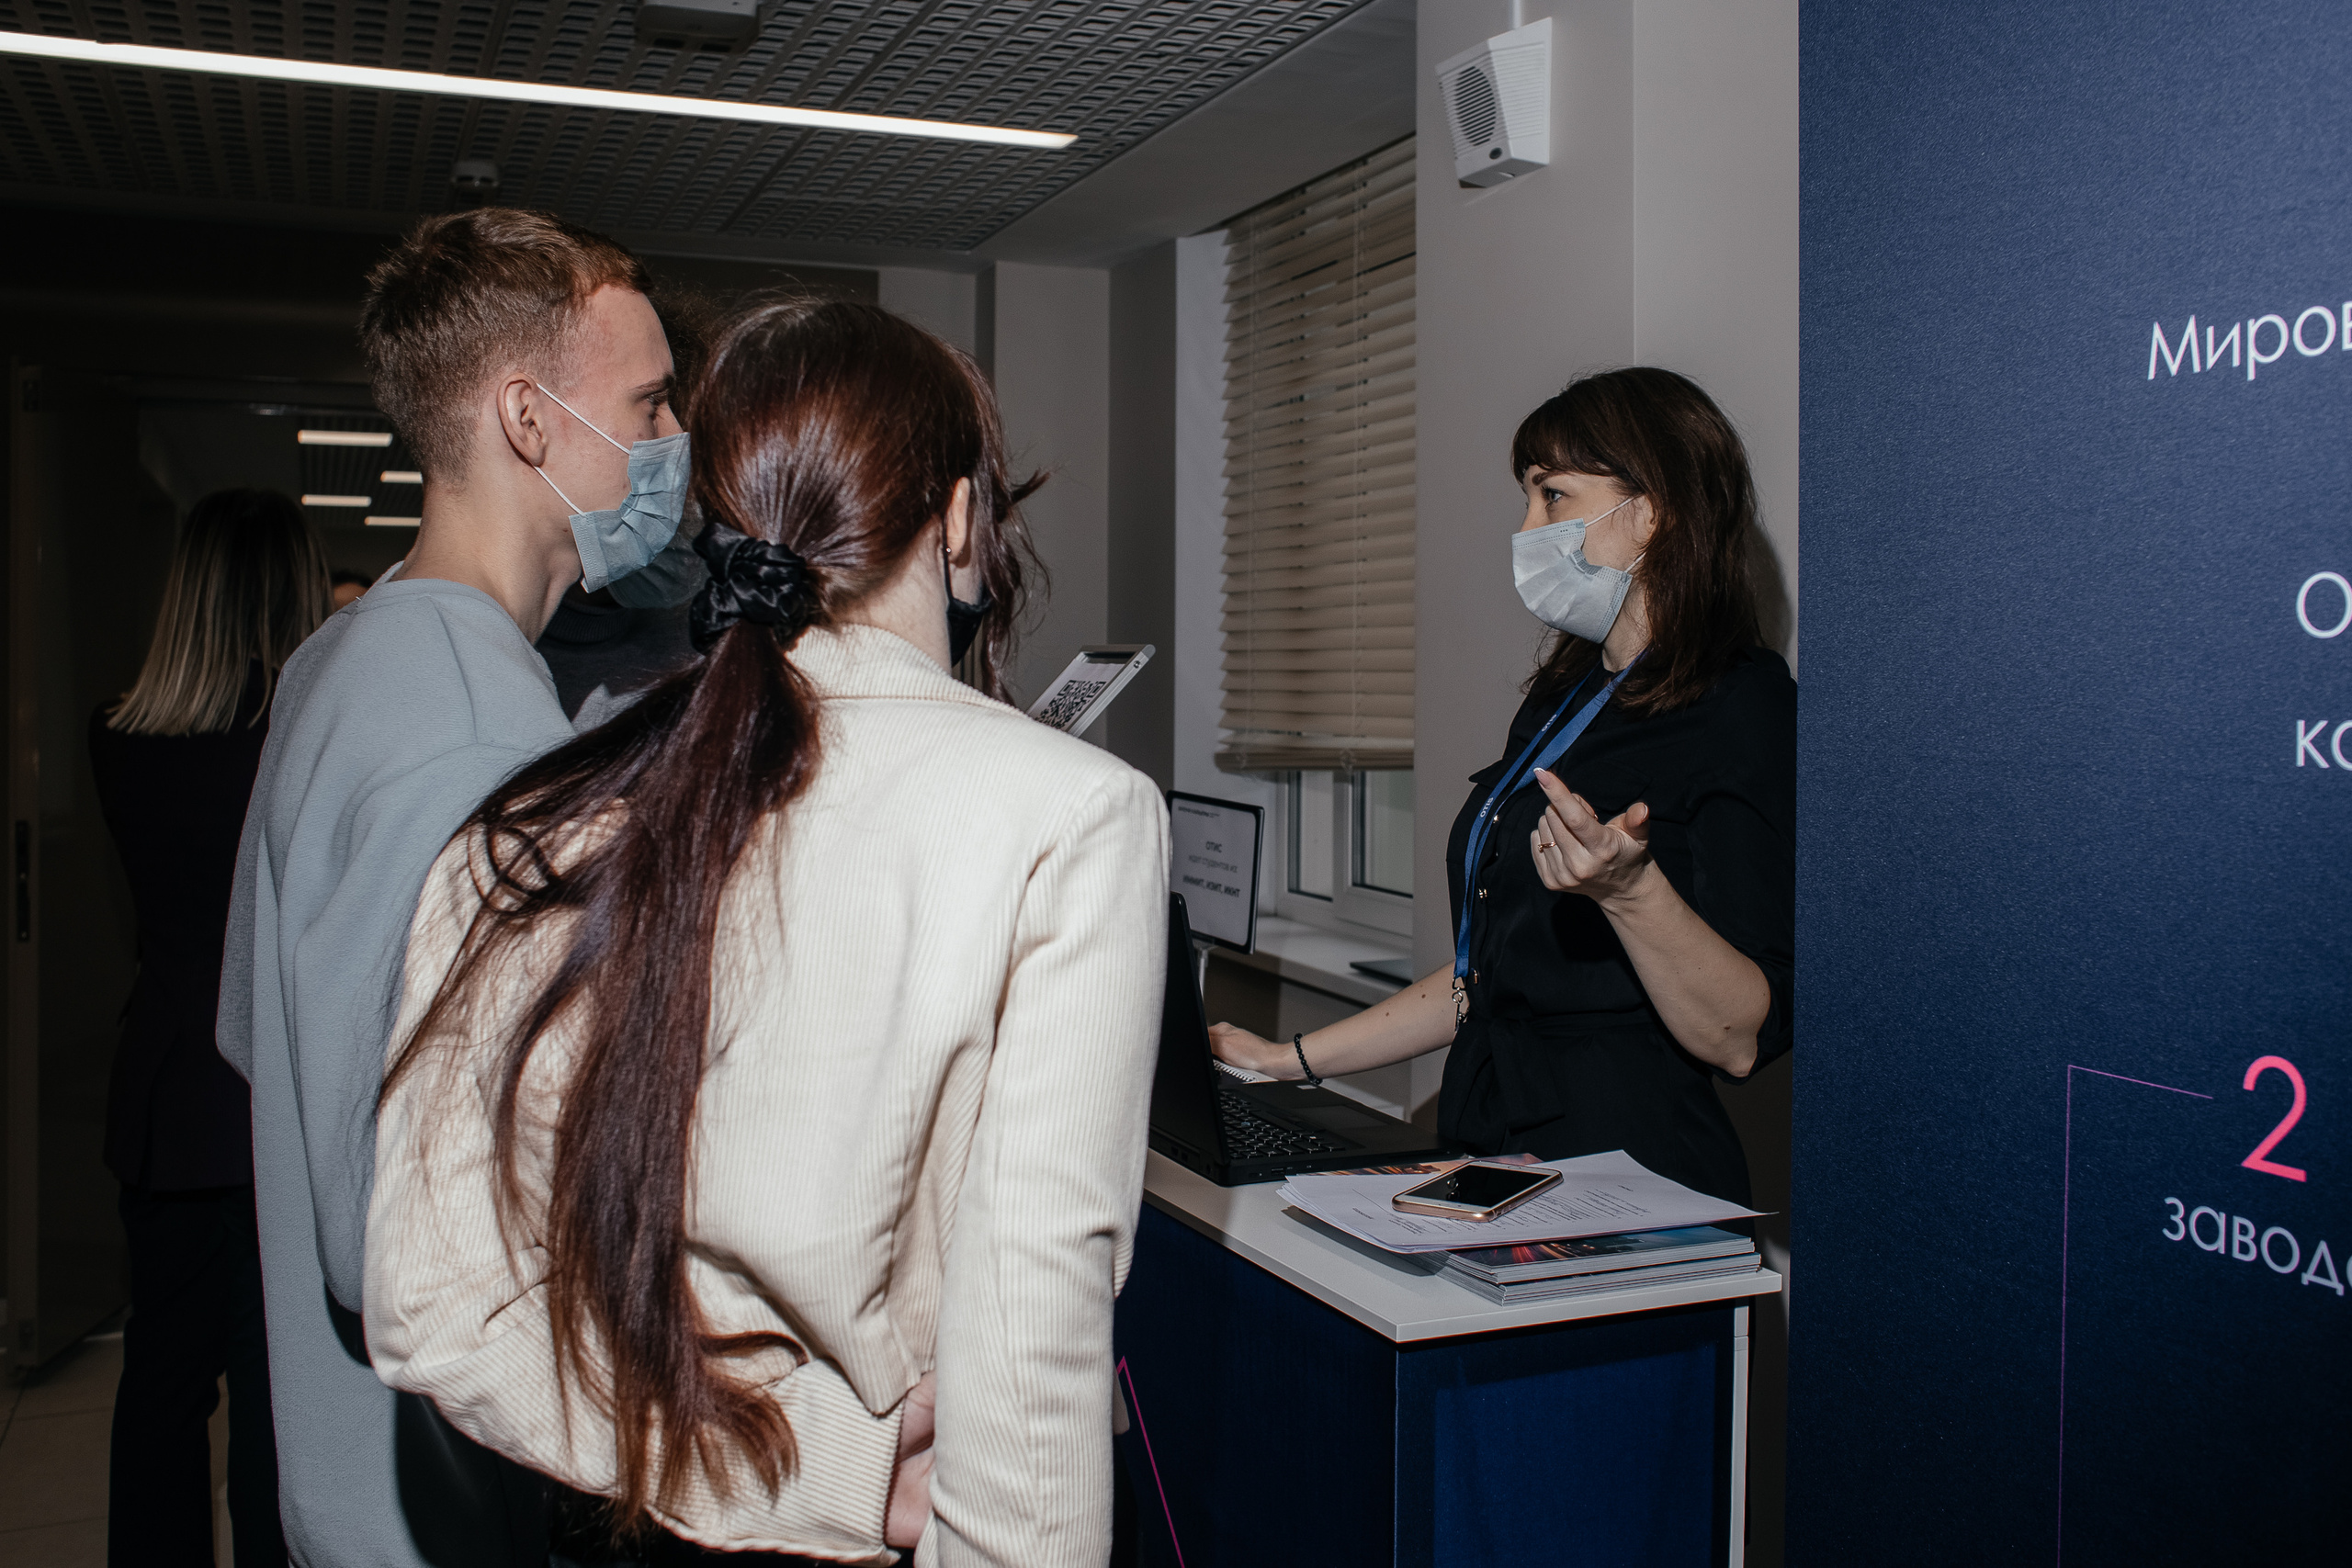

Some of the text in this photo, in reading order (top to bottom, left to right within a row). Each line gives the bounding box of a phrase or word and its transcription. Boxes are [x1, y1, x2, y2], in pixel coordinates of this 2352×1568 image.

[1541, 714, 1557, 732] OTIS
[1479, 796, 1494, 818] OTIS
[2241, 1055, 2307, 1182] 2
[2162, 1196, 2352, 1296] завод
